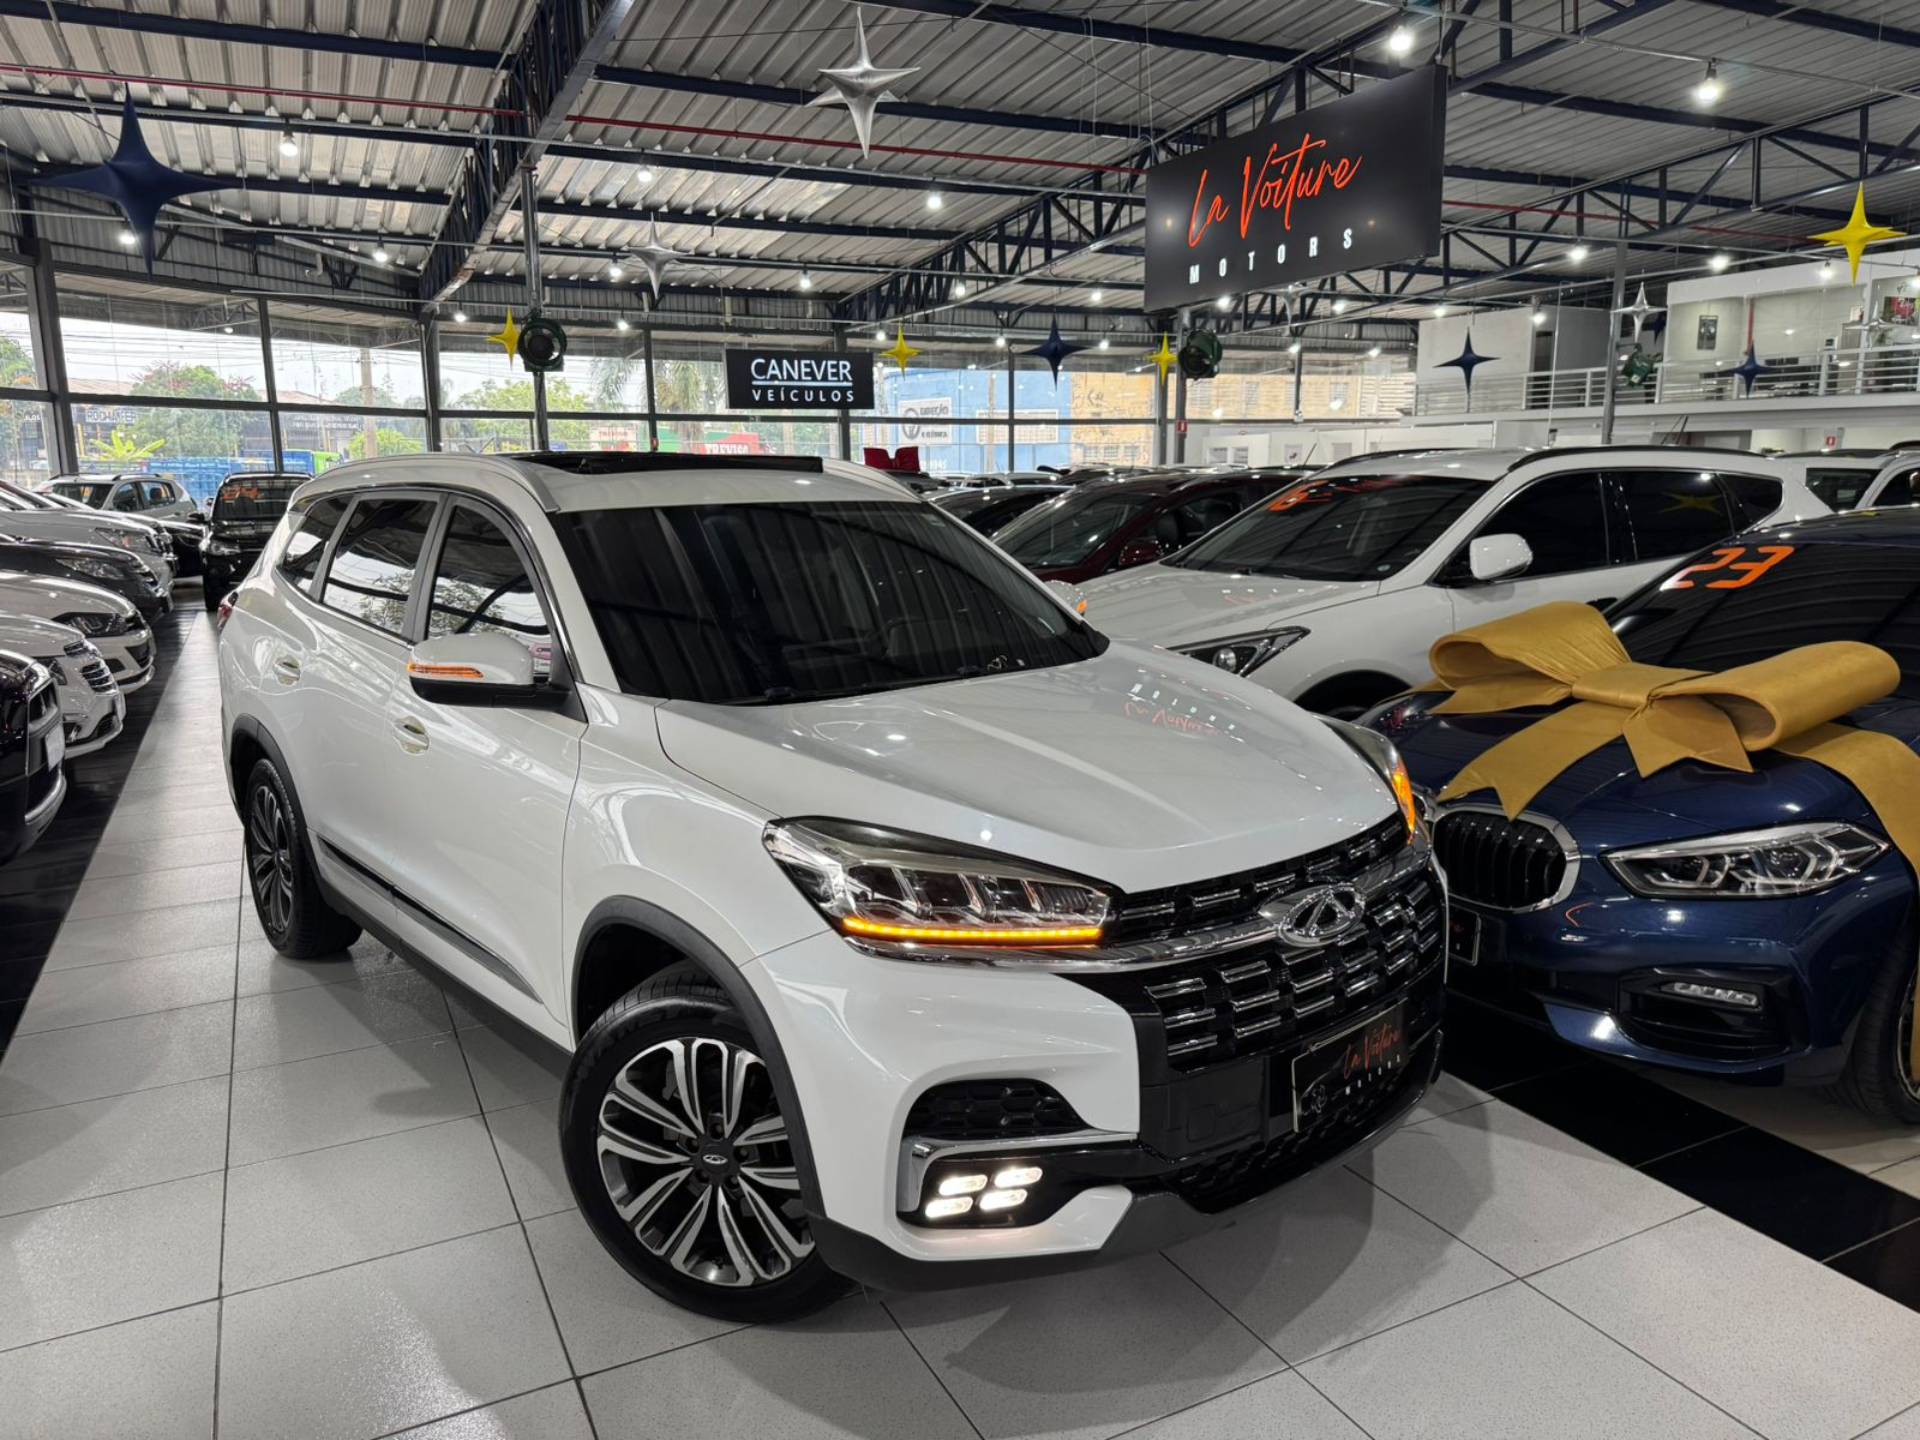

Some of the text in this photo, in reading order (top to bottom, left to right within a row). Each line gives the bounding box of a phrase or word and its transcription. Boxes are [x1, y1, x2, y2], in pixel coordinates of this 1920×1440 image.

[1188, 133, 1363, 248] La Voiture
[1189, 228, 1353, 284] MOTORS
[751, 359, 853, 381] CANEVER
[752, 387, 854, 402] VEÍCULOS
[1659, 546, 1794, 589] 23
